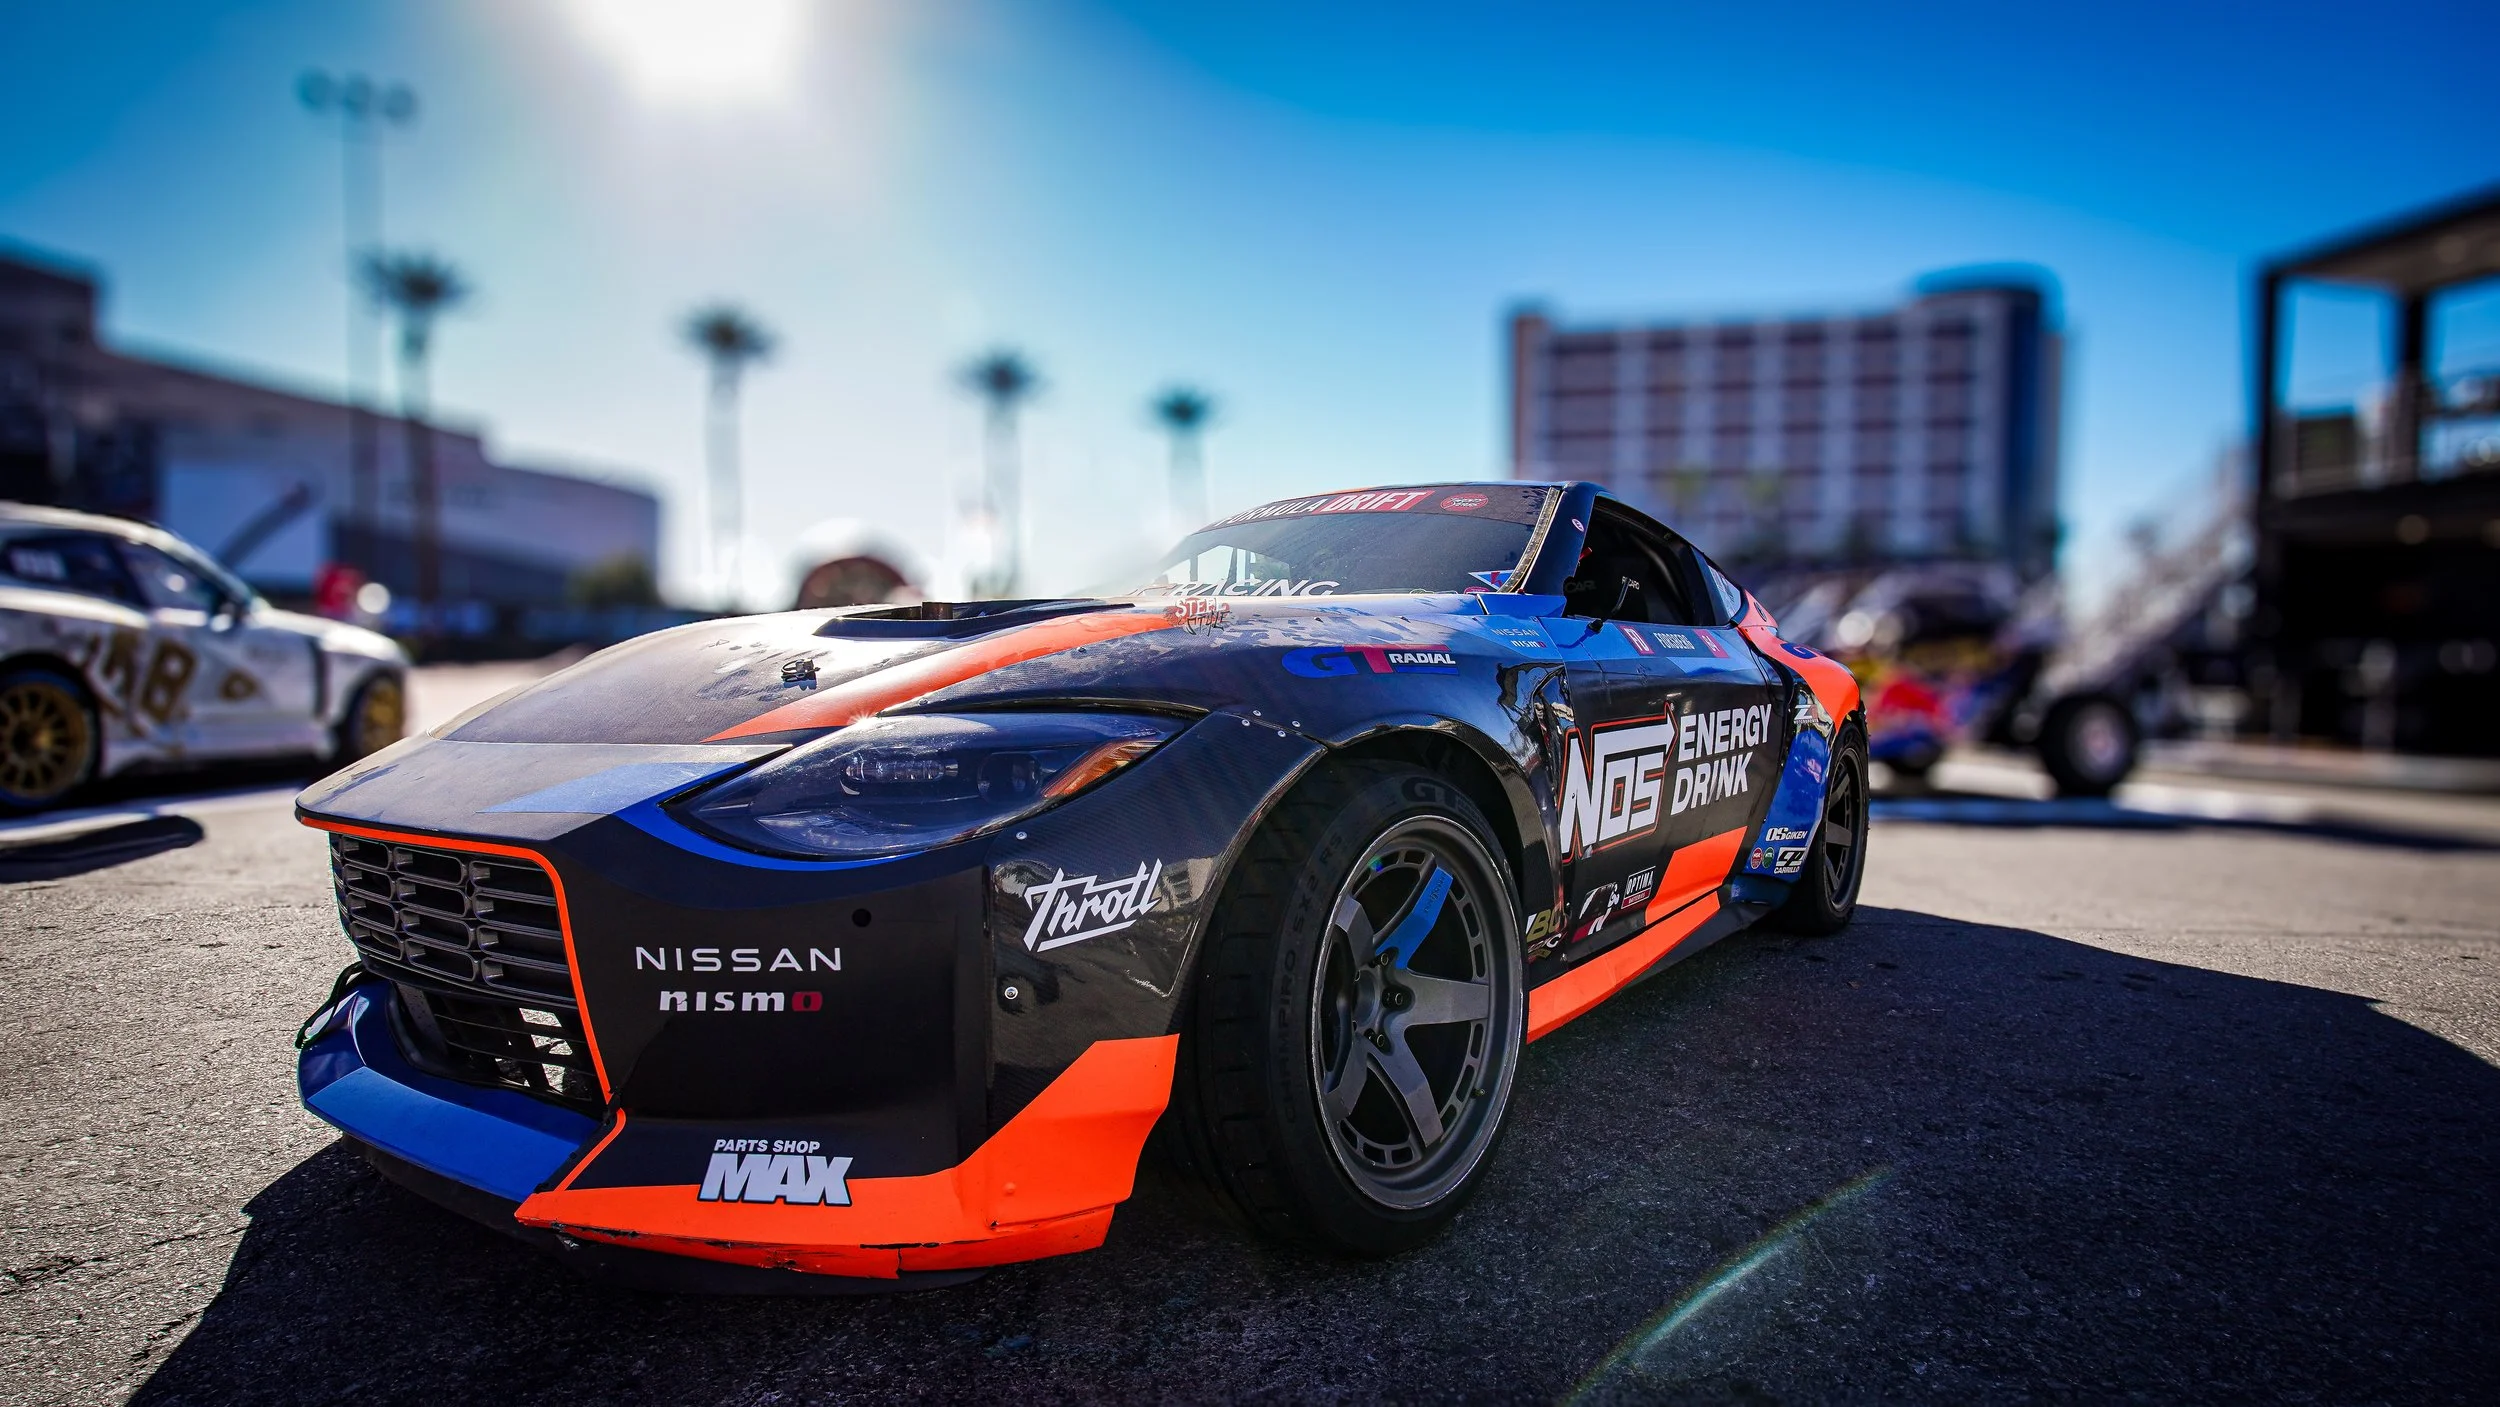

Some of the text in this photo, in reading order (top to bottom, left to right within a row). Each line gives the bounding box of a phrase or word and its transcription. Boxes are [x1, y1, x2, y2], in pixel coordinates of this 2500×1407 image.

[1321, 492, 1427, 512] DRIFT
[1490, 628, 1540, 636] NISSAN
[1388, 653, 1456, 665] RADIAL
[1677, 703, 1772, 763] ENERGY
[1560, 712, 1676, 854] NOS
[1670, 751, 1753, 816] DRINK
[1626, 871, 1654, 895] OPTIMA
[1023, 858, 1163, 952] Throtl
[635, 946, 841, 972] NISSAN
[659, 990, 823, 1012] nismo
[714, 1139, 820, 1153] PARTS SHOP
[699, 1153, 854, 1204] MAX
